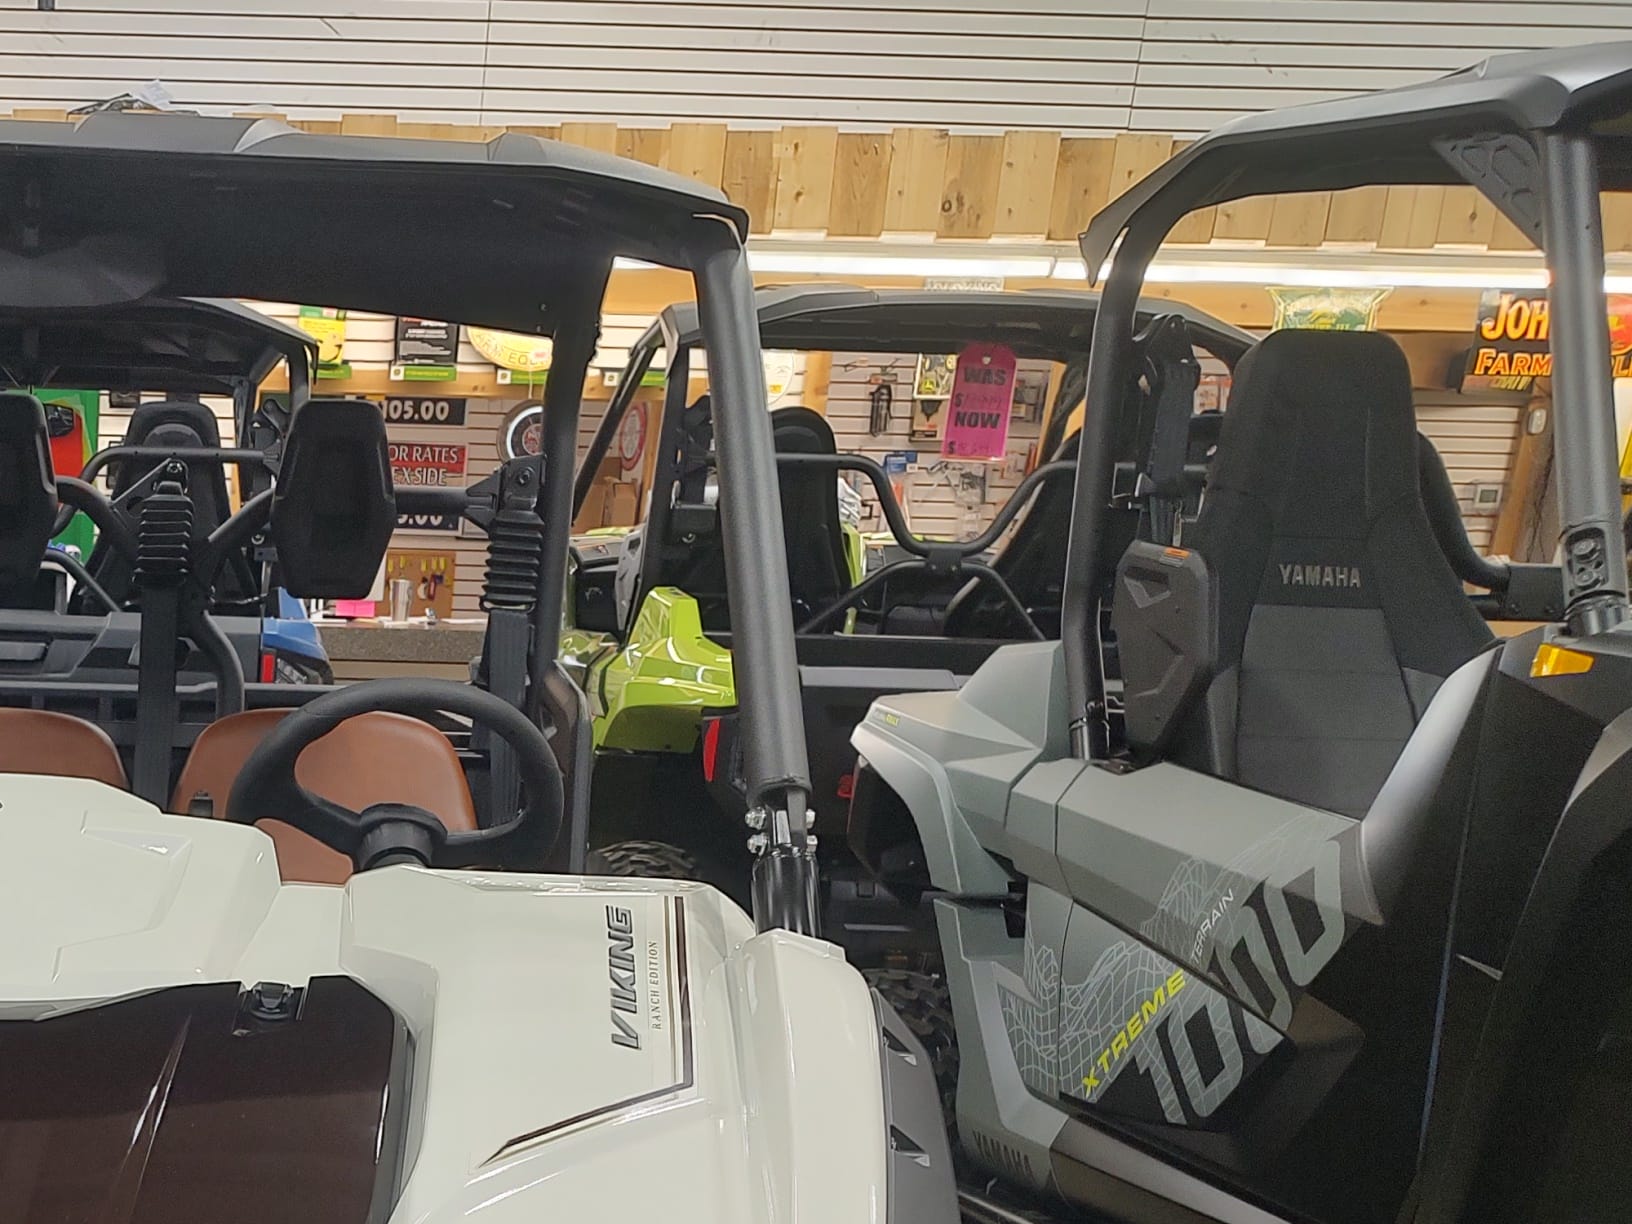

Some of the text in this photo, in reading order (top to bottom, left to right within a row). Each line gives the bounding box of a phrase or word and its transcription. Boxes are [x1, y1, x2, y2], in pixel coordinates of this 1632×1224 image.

[1480, 292, 1550, 340] JOH
[964, 367, 1007, 386] WAS
[1473, 348, 1552, 376] FARM
[954, 412, 1000, 429] NOW
[388, 445, 458, 464] OR RATES
[414, 467, 448, 487] SIDE
[1278, 563, 1361, 588] YAMAHA
[1190, 888, 1234, 964] TERRAIN
[605, 904, 642, 1050] VIKING
[648, 940, 662, 1030] RANCH EDITION
[1140, 838, 1345, 1125] 1000
[1082, 968, 1186, 1098] XTREME
